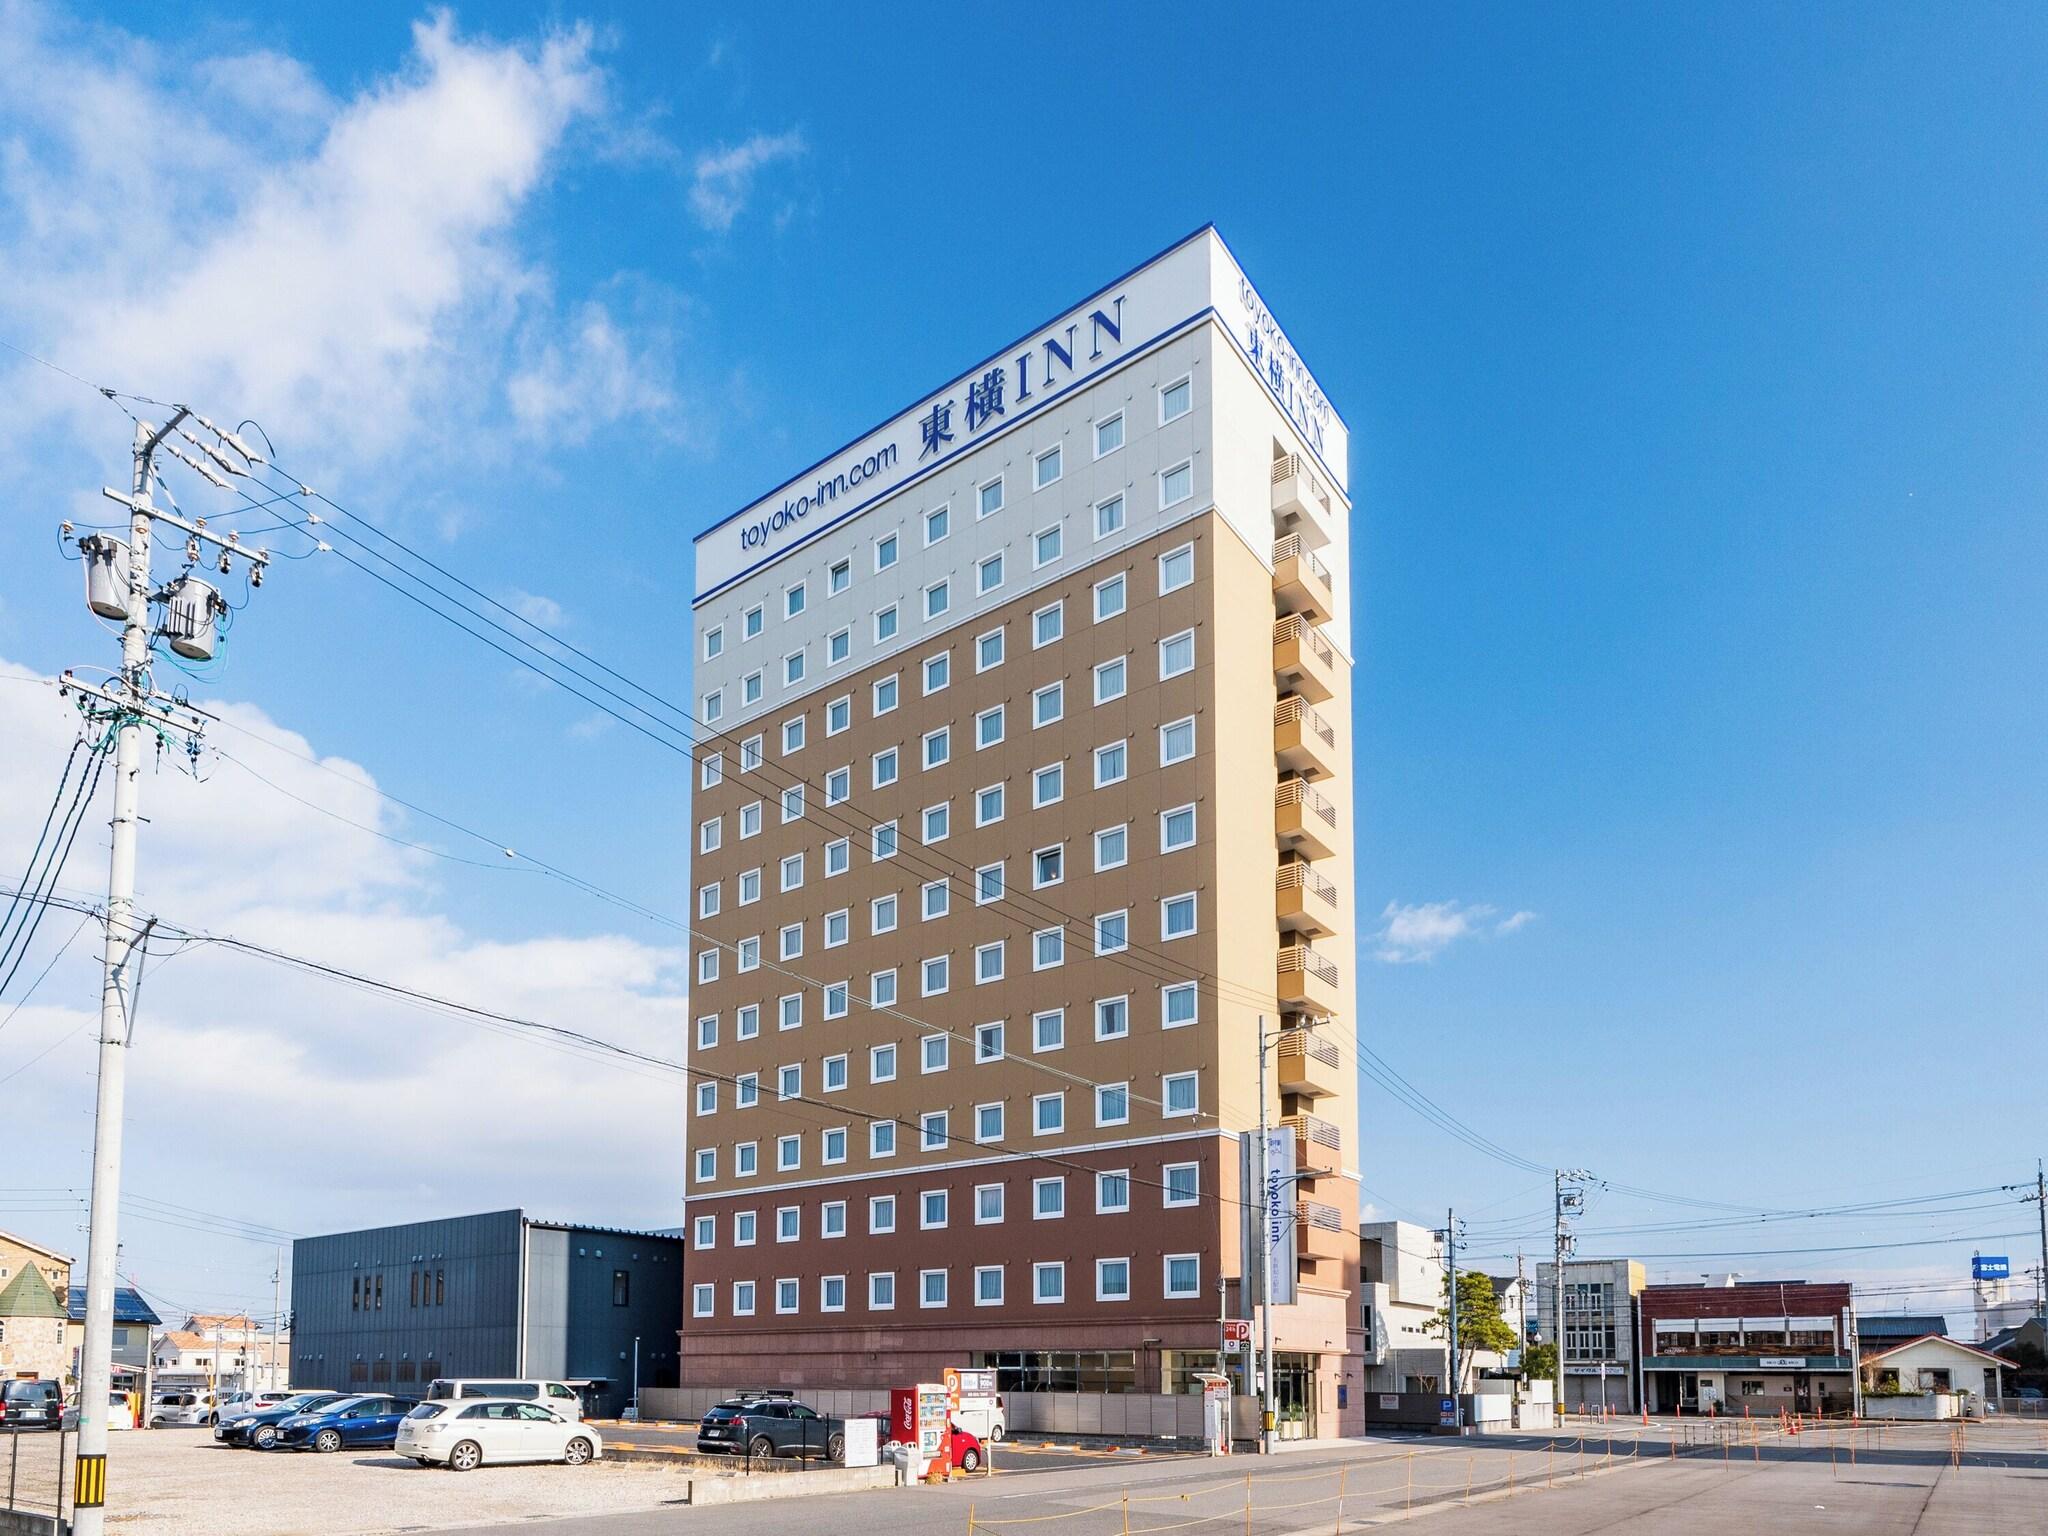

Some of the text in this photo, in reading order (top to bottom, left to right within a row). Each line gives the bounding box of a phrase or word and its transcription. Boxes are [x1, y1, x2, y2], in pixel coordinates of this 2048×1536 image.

[918, 295, 1127, 461] 東横INN
[1238, 276, 1330, 425] toyoko-inn.com
[1247, 322, 1324, 457] 東横INN
[741, 440, 897, 552] toyoko-inn.com
[1269, 1168, 1282, 1242] toyoko inn
[1442, 1400, 1452, 1411] P
